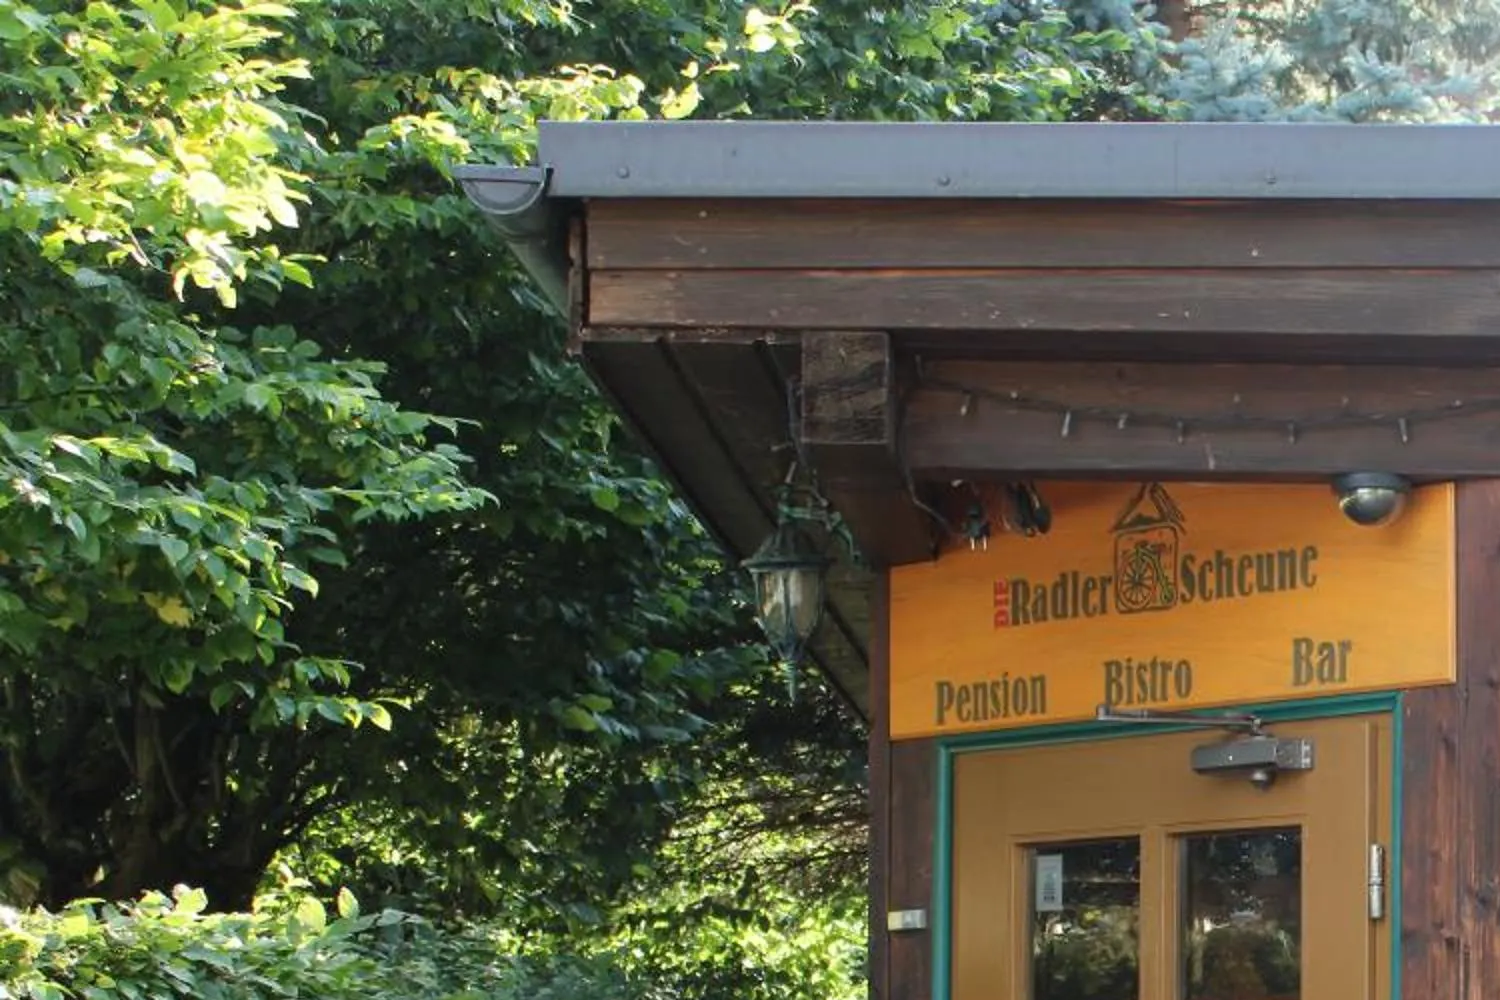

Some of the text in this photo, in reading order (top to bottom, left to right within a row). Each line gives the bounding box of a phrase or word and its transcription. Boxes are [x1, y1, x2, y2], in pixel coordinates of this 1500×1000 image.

[994, 545, 1318, 629] DIE Radler Scheune
[935, 637, 1352, 725] Pension Bistro Bar
